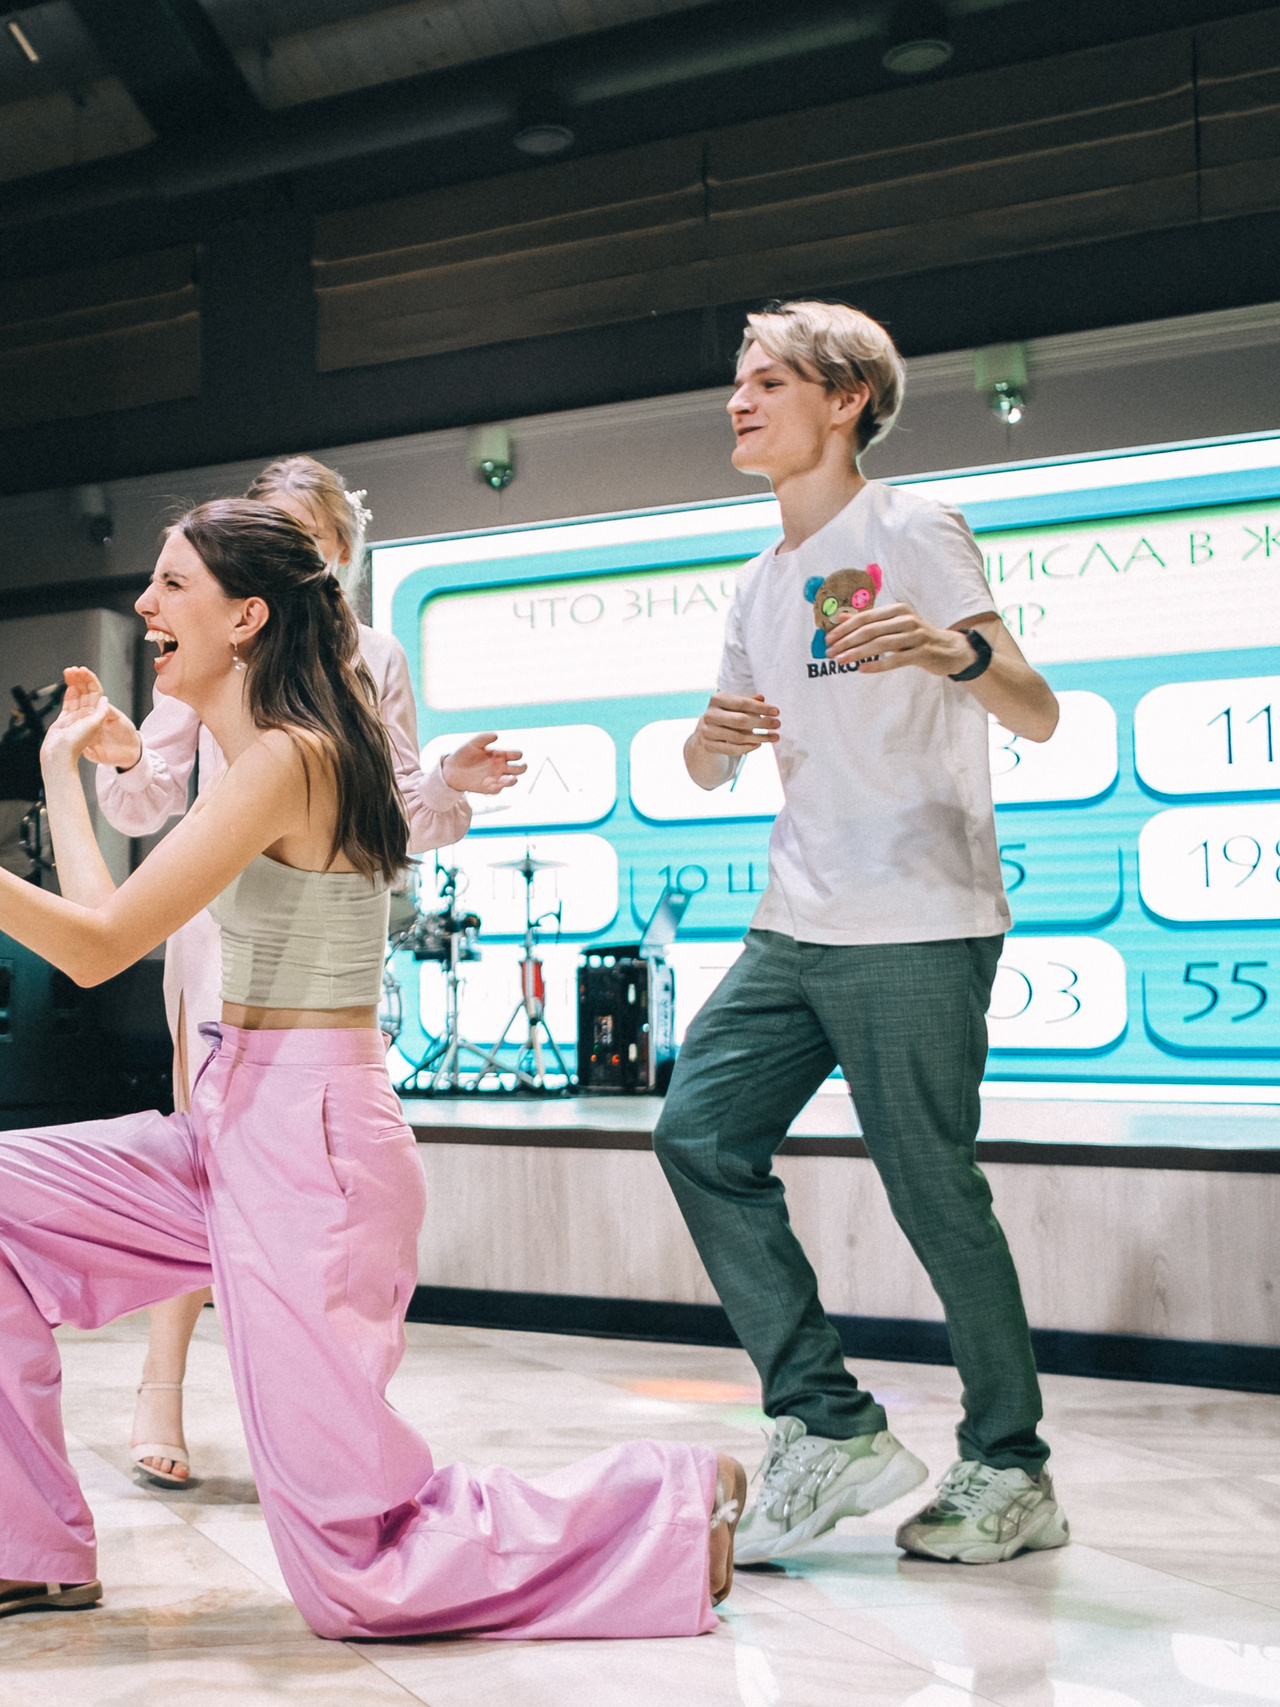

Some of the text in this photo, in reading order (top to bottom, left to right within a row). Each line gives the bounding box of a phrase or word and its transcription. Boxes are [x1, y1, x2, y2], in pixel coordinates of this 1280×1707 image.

[513, 593, 605, 629] ЧТО
[1190, 530, 1214, 565] В
[1206, 704, 1273, 764] 11
[1183, 961, 1269, 1023] 55
